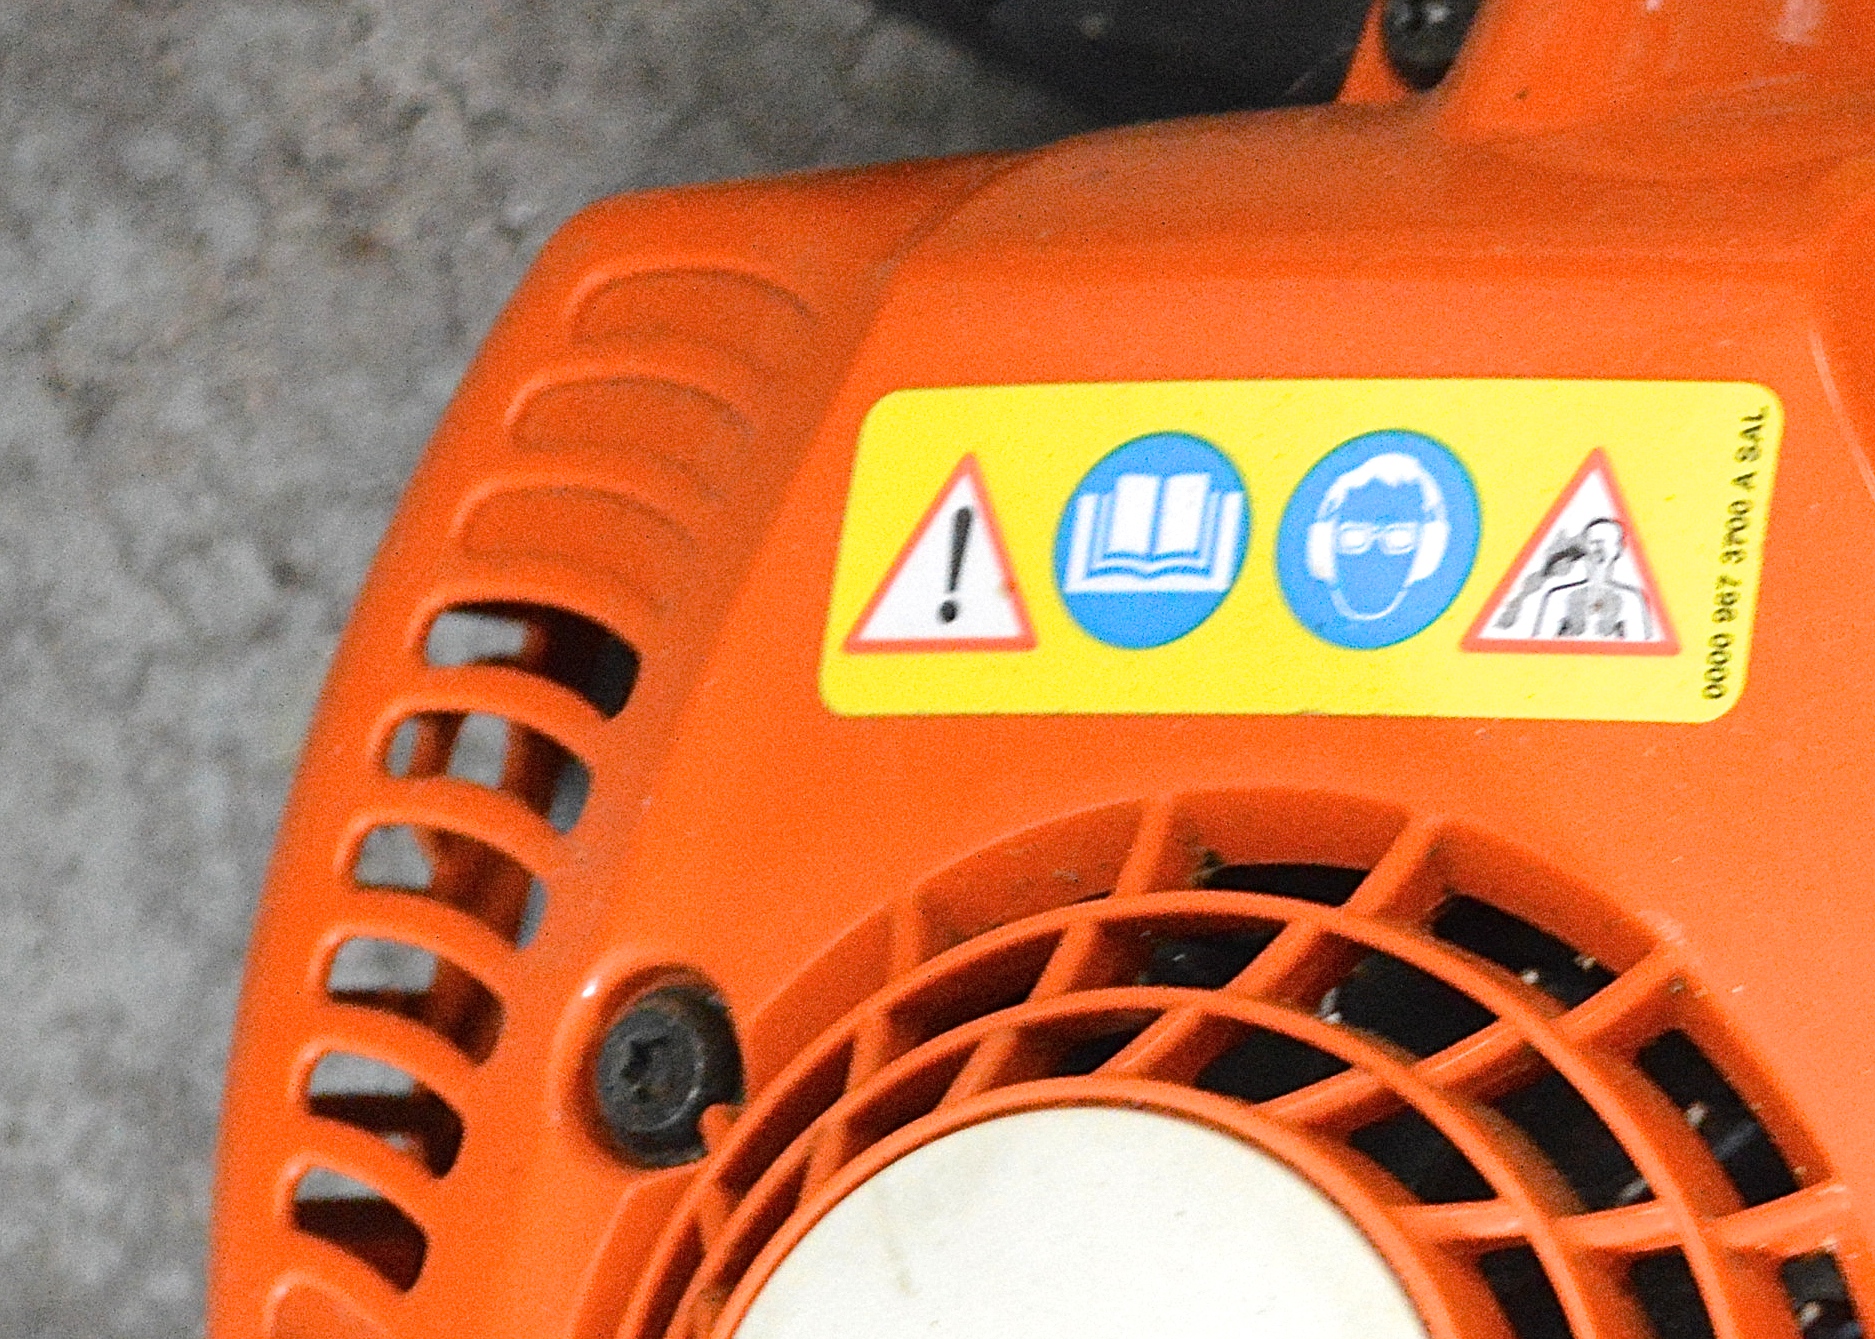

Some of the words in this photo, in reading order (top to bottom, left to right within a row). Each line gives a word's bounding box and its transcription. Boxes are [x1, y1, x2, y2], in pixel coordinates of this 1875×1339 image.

[1734, 404, 1769, 463] SAL
[1730, 471, 1757, 491] A
[1719, 499, 1754, 564] 3700
[1710, 574, 1742, 623] 967
[1701, 632, 1736, 700] 0000
